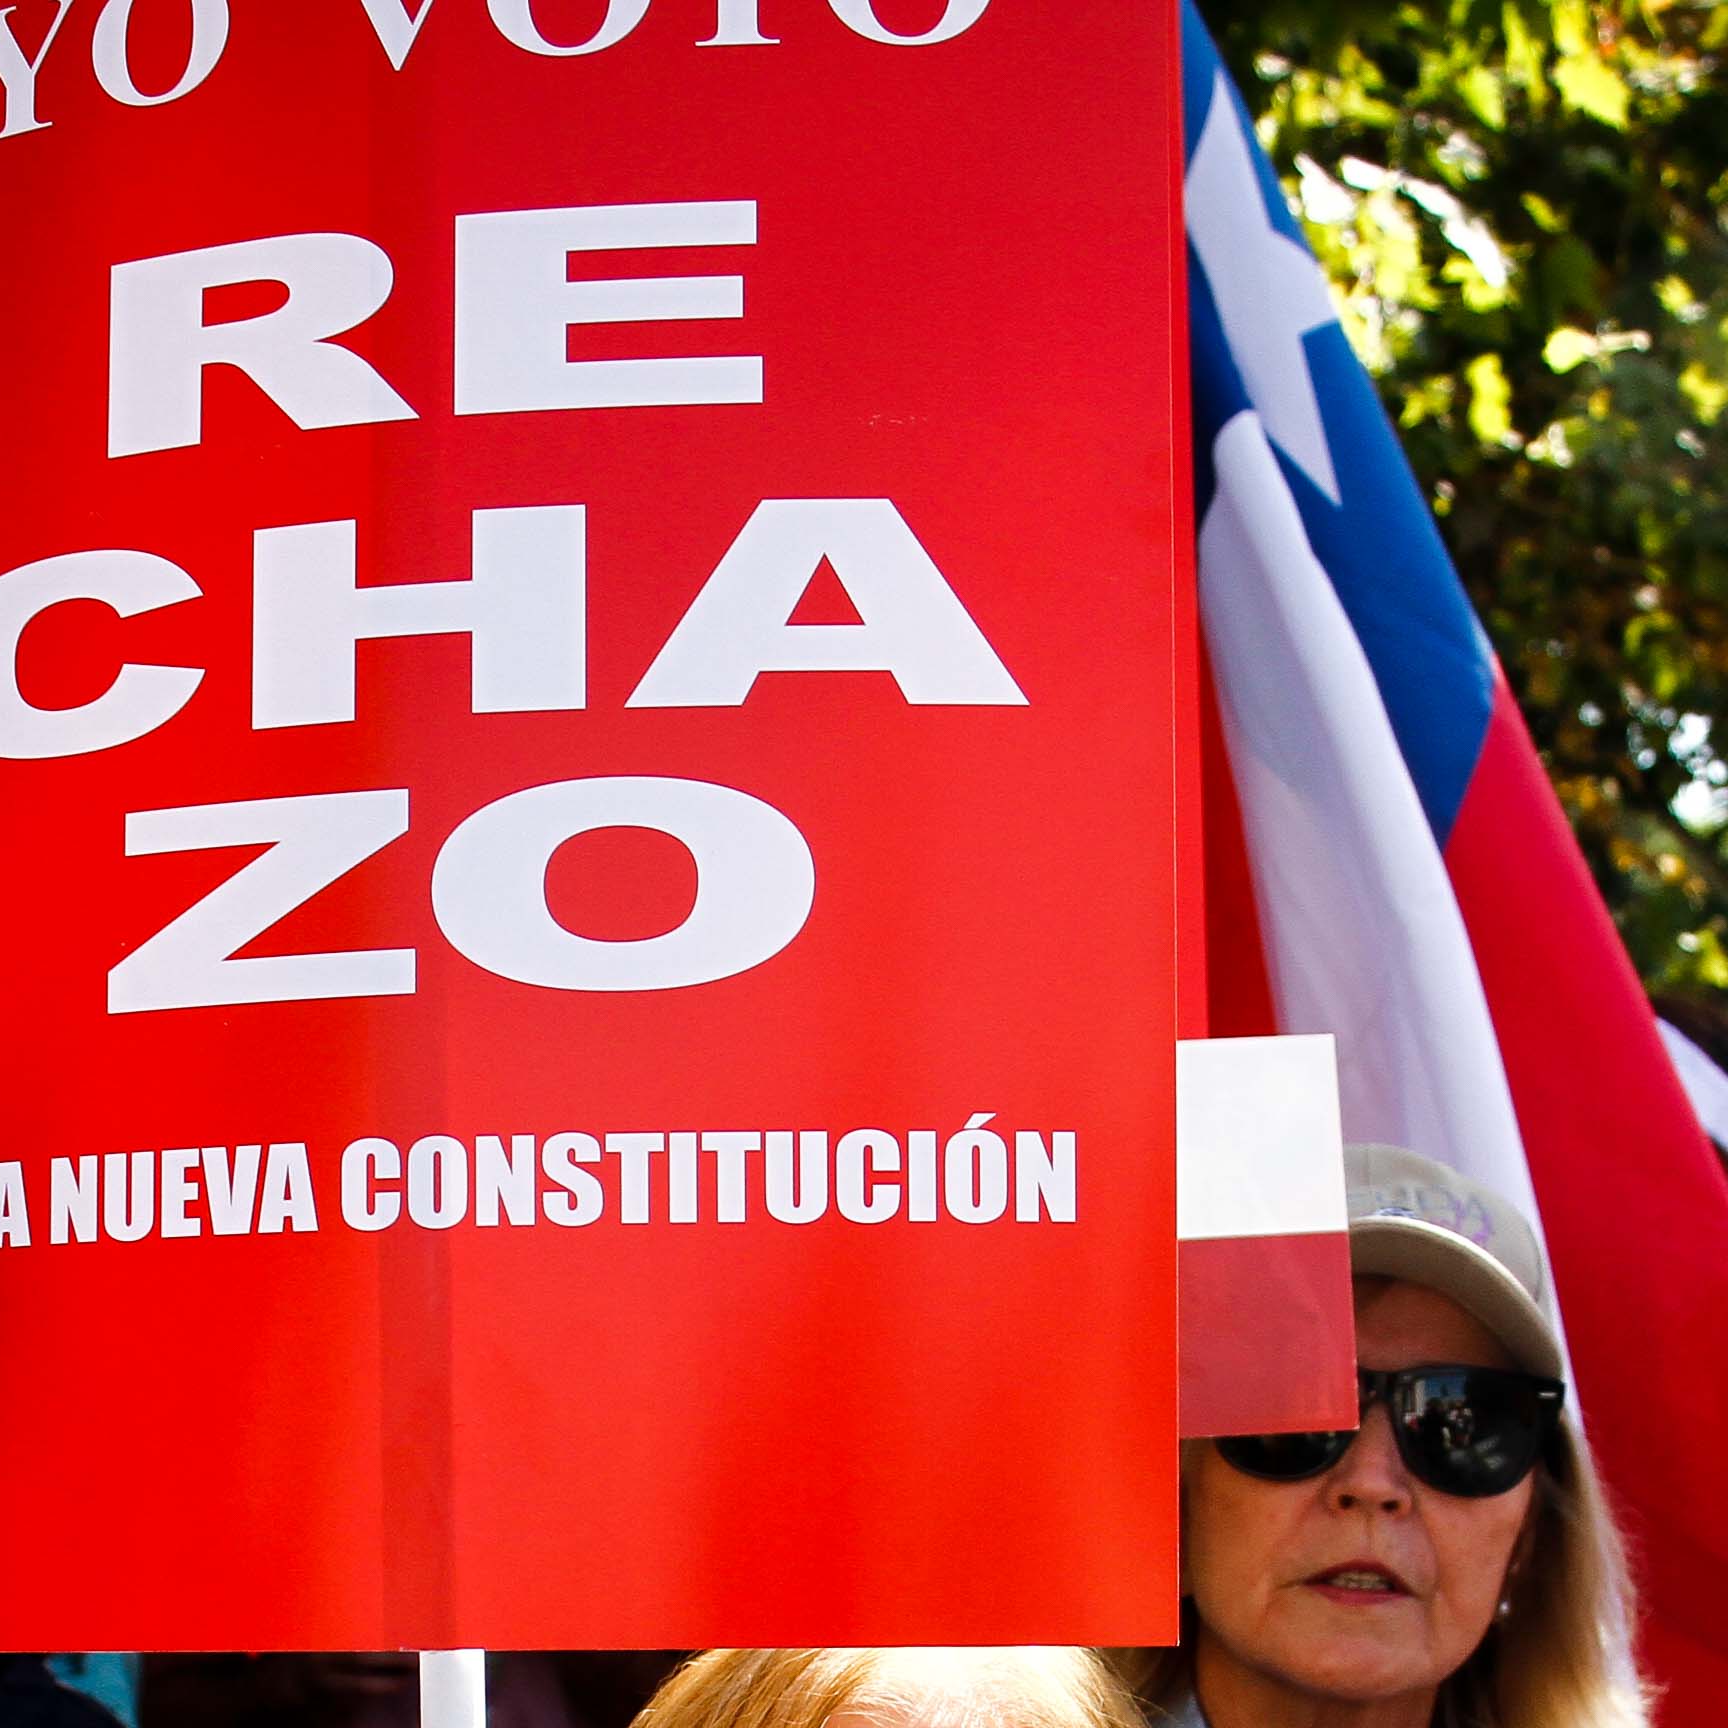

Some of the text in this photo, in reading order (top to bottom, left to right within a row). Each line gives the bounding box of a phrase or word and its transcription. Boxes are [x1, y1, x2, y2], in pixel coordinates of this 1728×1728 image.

[107, 199, 764, 459] RE
[107, 776, 816, 1015] ZO
[50, 1142, 319, 1245] NUEVA
[341, 1112, 1078, 1232] CONSTITUCIÓN
